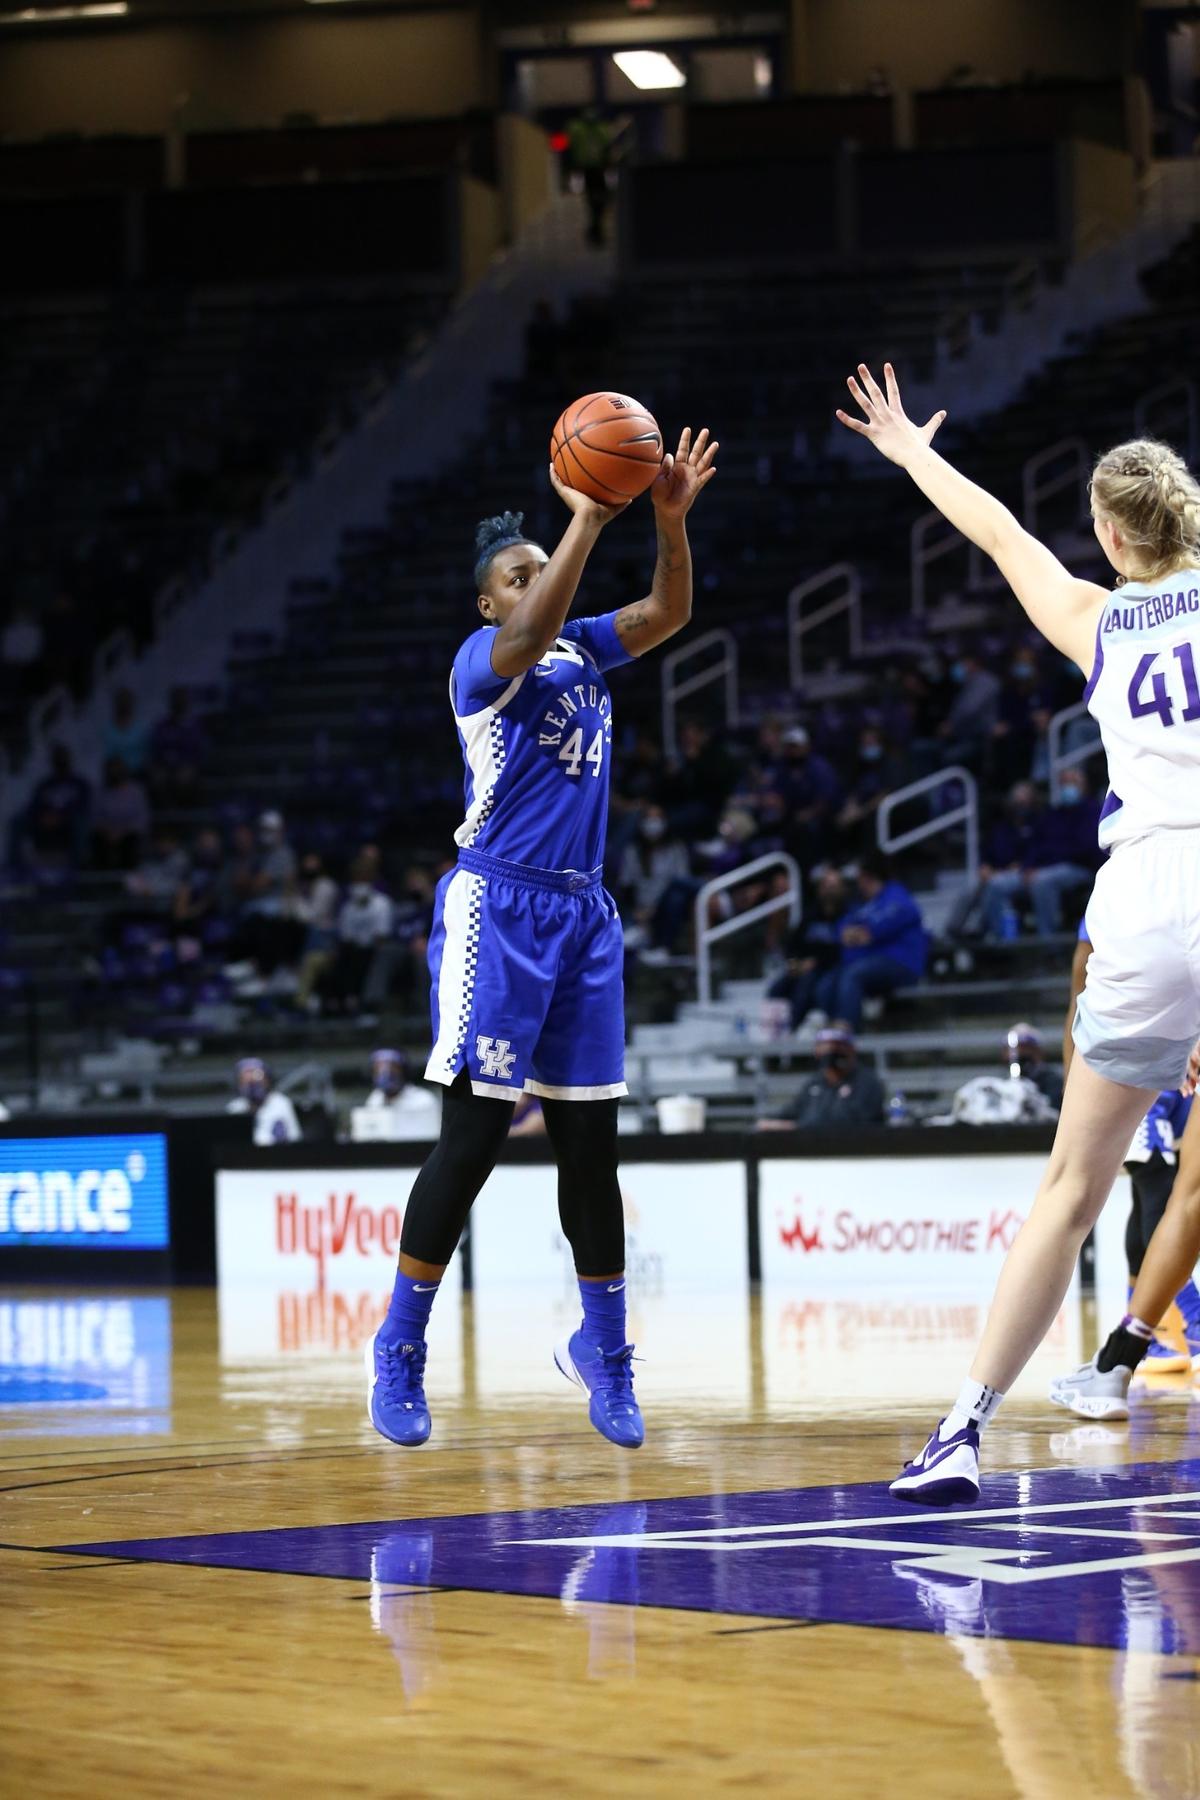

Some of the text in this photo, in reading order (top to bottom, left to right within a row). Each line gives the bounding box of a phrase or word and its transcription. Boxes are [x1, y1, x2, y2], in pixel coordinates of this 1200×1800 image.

[1128, 642, 1200, 727] 41
[558, 728, 604, 778] 44
[476, 1035, 517, 1079] UK
[276, 1192, 400, 1288] HyVee
